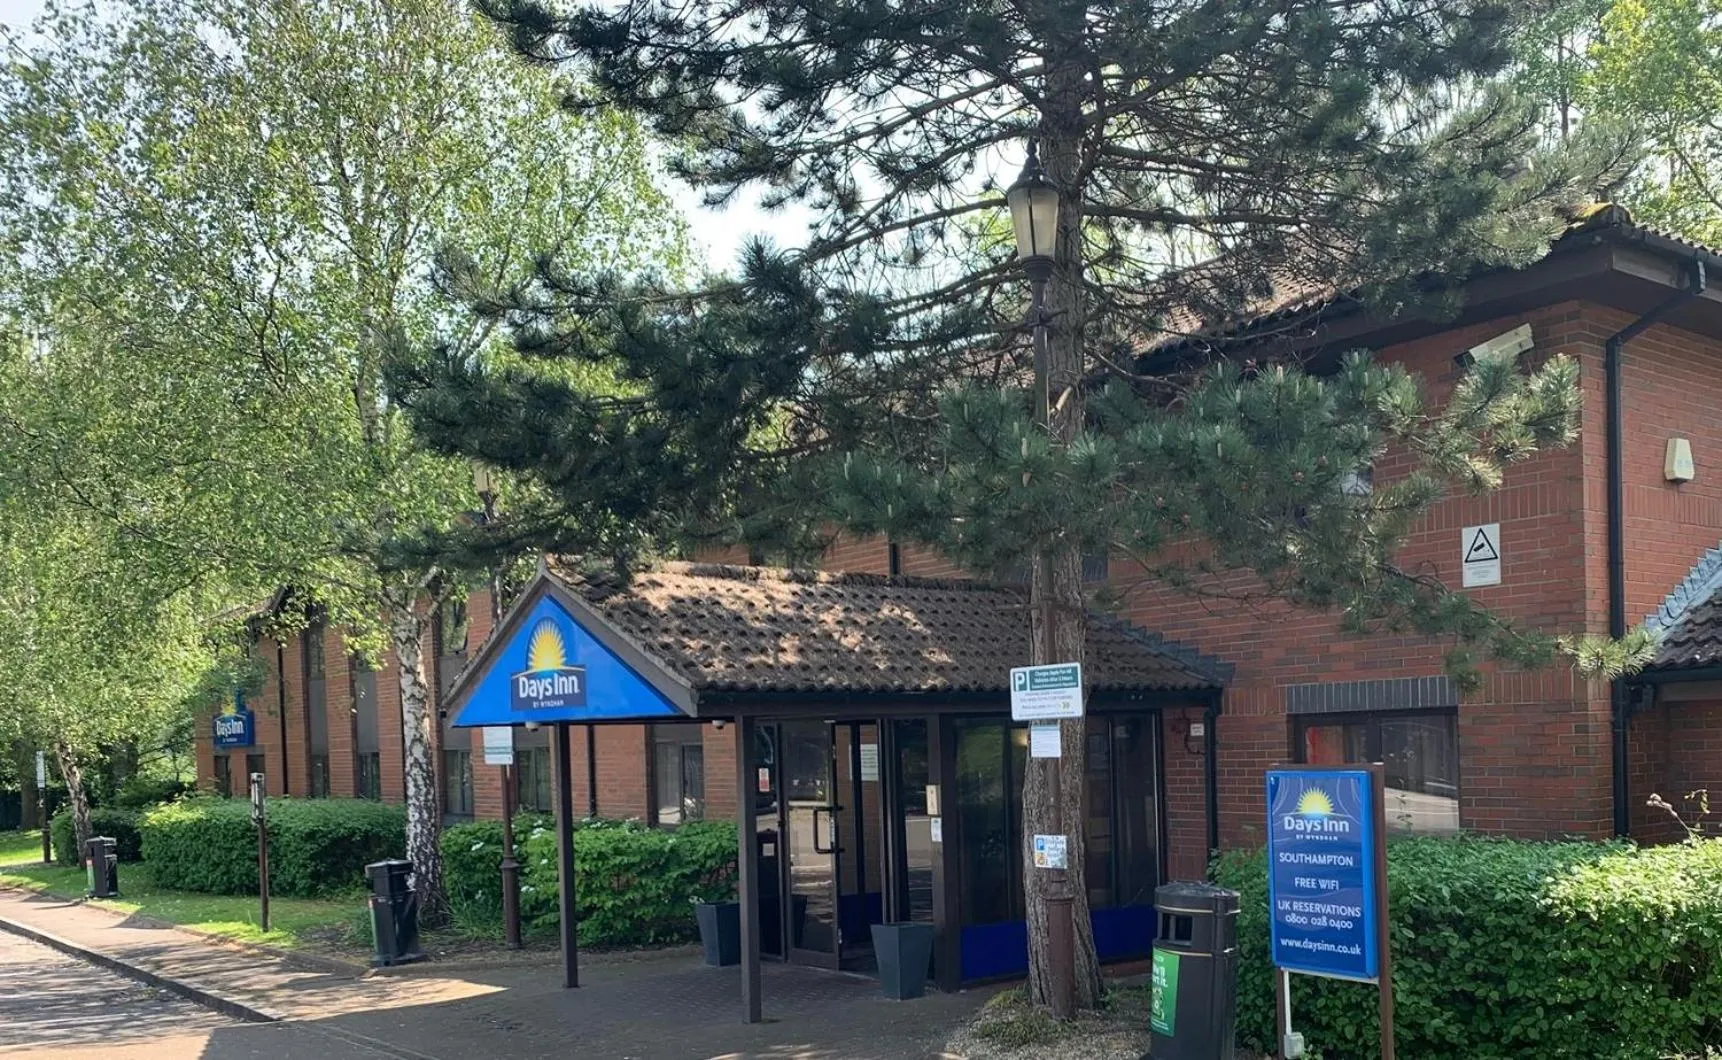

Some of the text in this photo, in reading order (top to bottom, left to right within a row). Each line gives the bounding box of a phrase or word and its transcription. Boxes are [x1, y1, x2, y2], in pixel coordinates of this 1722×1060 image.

[519, 672, 579, 700] Days Inn
[1284, 816, 1350, 833] Days Inn
[1279, 852, 1354, 867] SOUTHAMPTON
[1294, 877, 1340, 891] FREE WIFI
[1278, 900, 1361, 918] UK RESERVATIONS
[1285, 913, 1354, 931] 0800 028 0400
[1280, 938, 1361, 955] www.daysinn.co.uk
